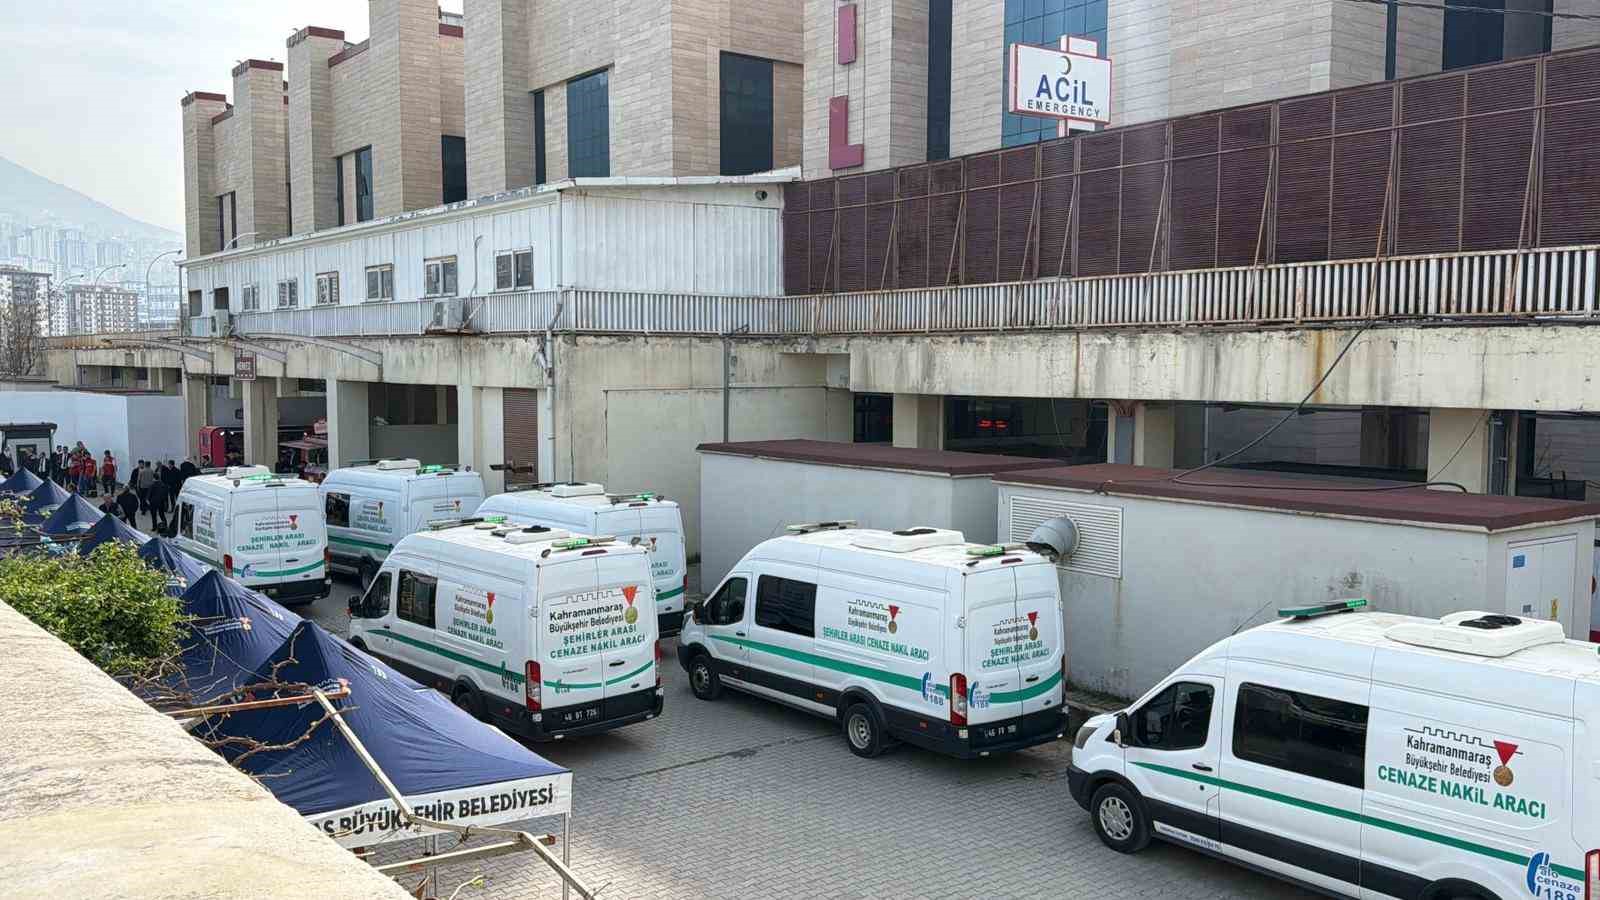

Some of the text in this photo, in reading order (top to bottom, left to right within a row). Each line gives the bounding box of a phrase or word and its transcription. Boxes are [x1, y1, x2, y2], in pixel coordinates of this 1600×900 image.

[1027, 99, 1100, 118] EMERGENCY
[549, 603, 623, 622] Kahramanmaraş
[549, 615, 623, 634] Büyükşehir Belediyesi
[612, 625, 637, 636] ARASI
[550, 645, 588, 659] CENAZE
[620, 635, 646, 648] ARACI
[1406, 735, 1492, 769] Kahramanmaraş
[1405, 752, 1491, 784] Büyükşehir Belediyesi
[1378, 765, 1437, 793] CENAZE
[1493, 793, 1546, 819] ARACI
[340, 798, 454, 834] BÜYÜKEHİR
[458, 784, 553, 817] BELEDİYESİ
[1537, 876, 1581, 893] cenaze
